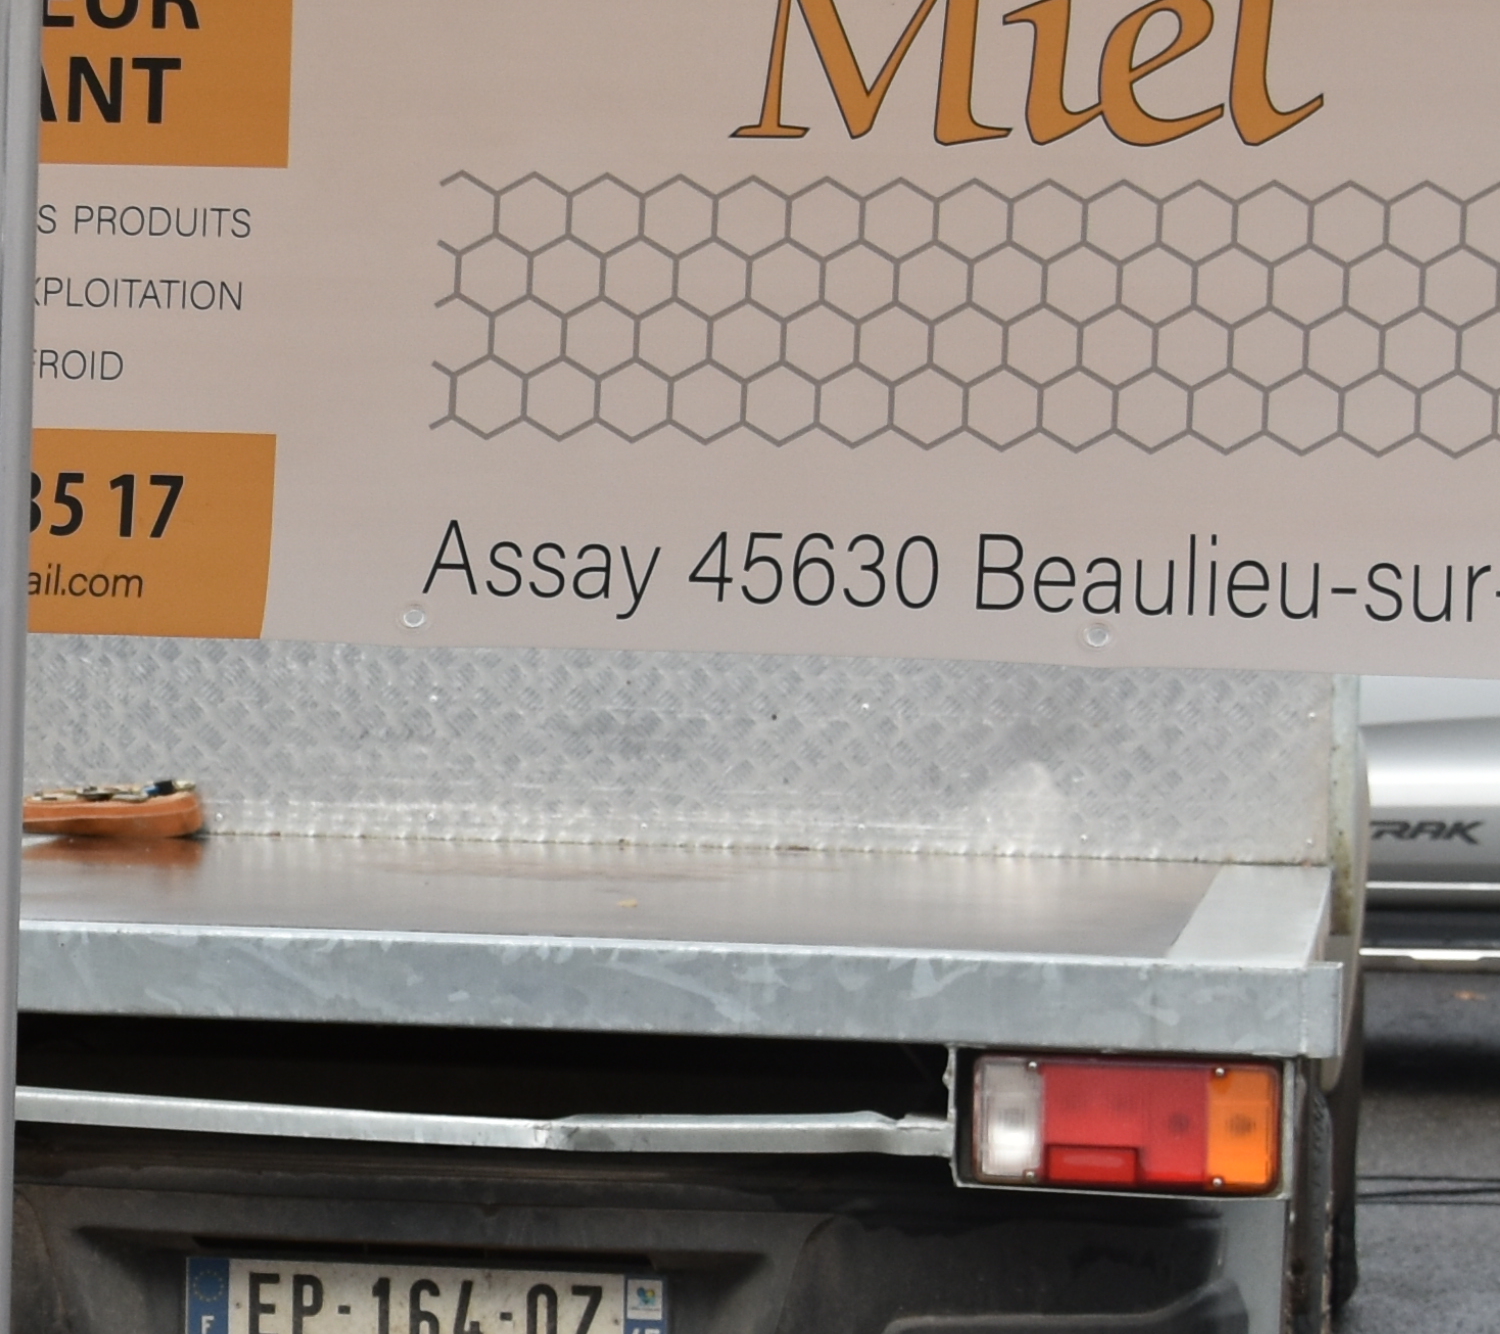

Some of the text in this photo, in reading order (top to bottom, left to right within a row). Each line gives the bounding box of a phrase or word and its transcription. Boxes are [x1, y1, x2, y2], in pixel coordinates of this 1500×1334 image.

[109, 473, 184, 538] 17
[423, 520, 661, 620] Assay
[688, 530, 939, 609] 45630
